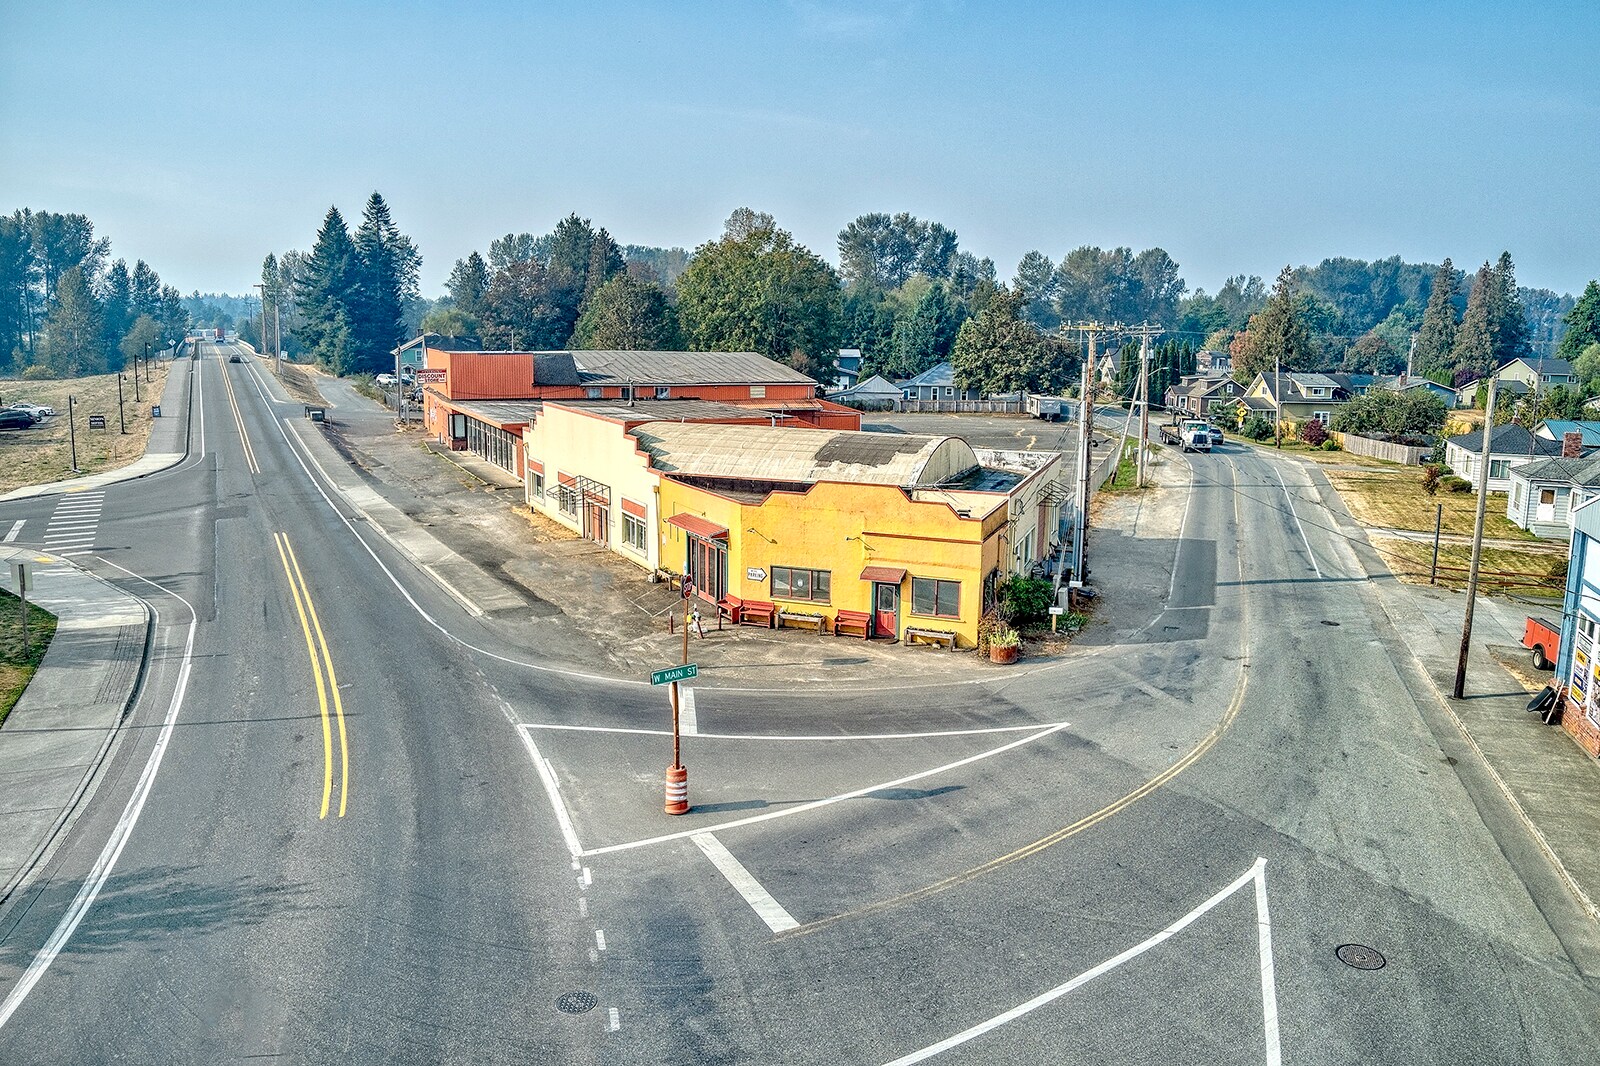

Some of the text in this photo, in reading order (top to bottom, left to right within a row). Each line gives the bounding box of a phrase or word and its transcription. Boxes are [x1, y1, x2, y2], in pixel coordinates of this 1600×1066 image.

[653, 666, 696, 683] W MAIN ST
